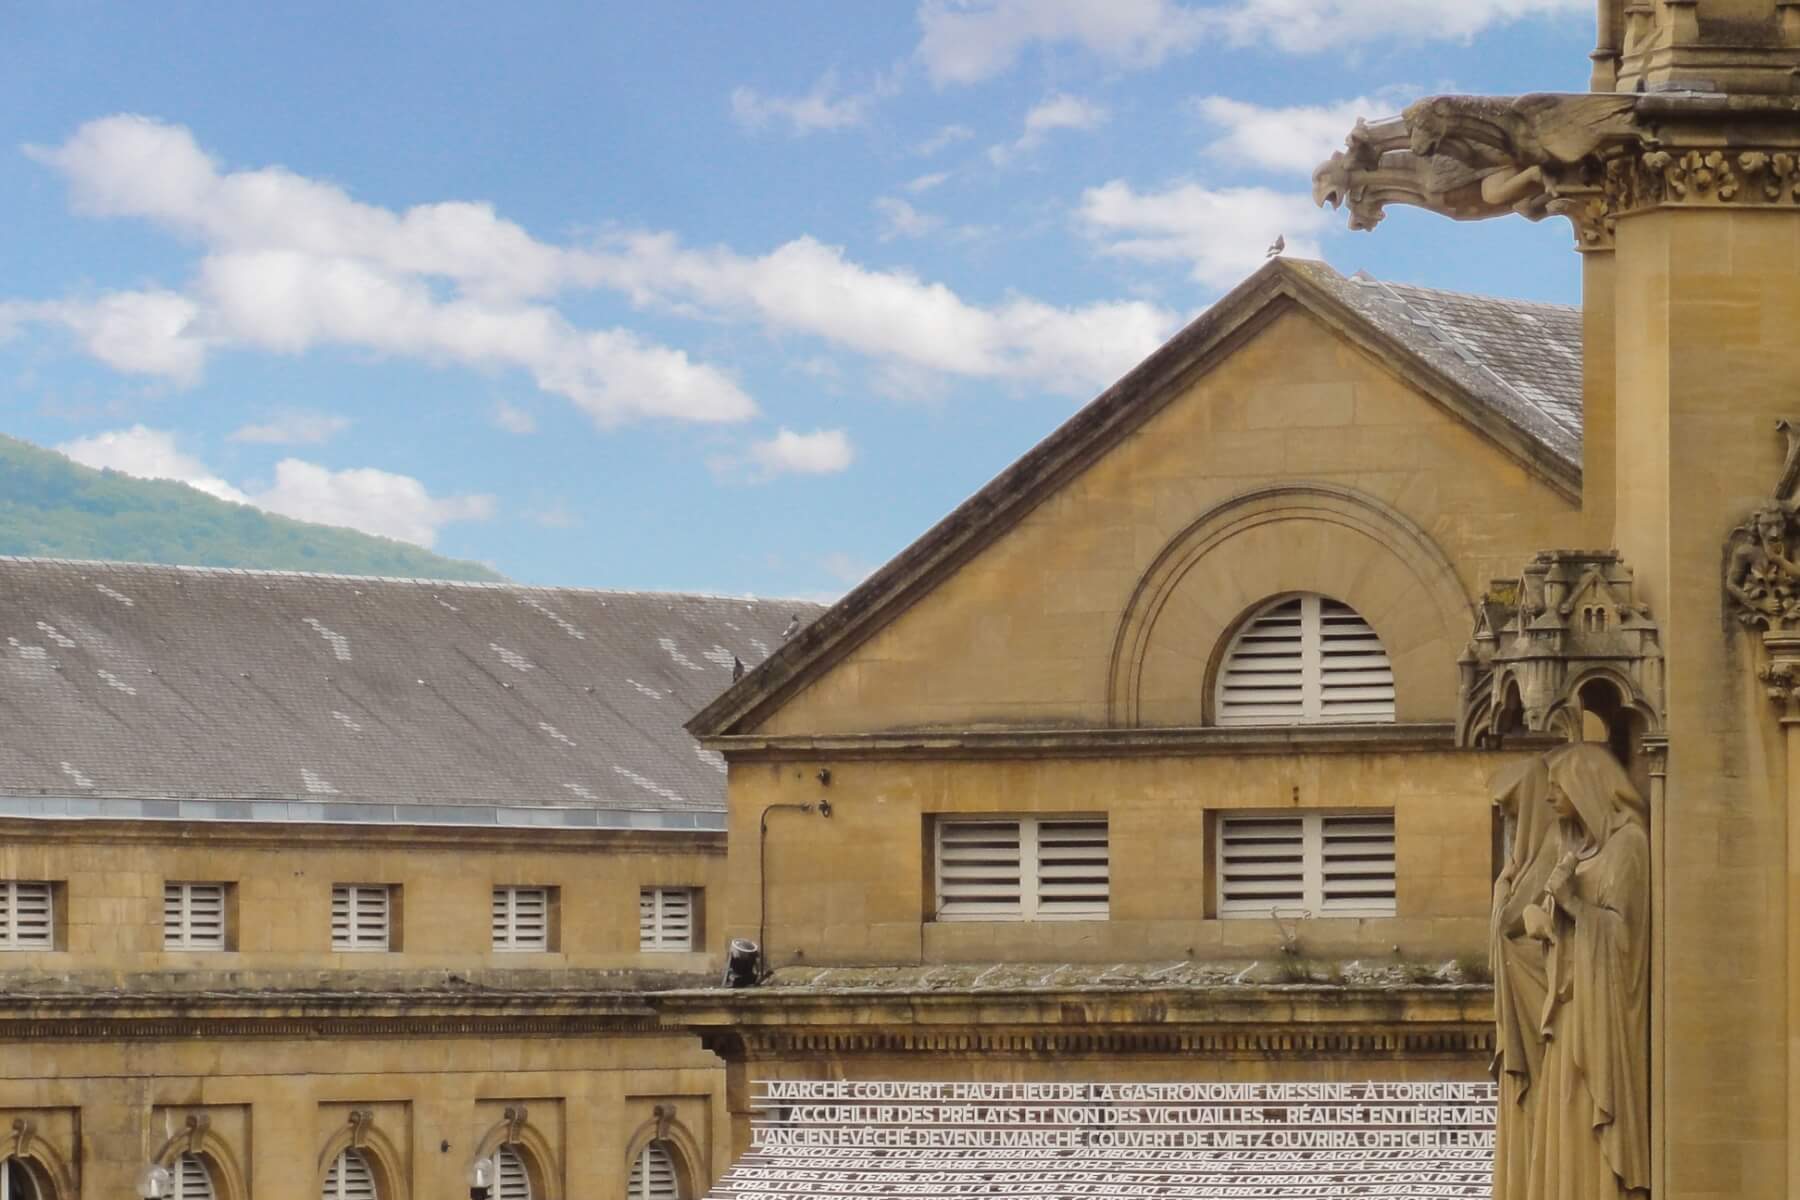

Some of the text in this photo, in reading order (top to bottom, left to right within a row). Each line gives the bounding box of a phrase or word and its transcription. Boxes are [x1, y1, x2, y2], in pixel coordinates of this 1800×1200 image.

[767, 1079, 849, 1099] MARCHÉ
[854, 1084, 947, 1104] COUVERT,
[953, 1084, 1009, 1100] HAUT
[1012, 1085, 1054, 1100] LIEU
[1058, 1085, 1084, 1100] DE
[1090, 1085, 1114, 1100] LA
[1119, 1085, 1262, 1100] GASTRONOMIE
[1363, 1080, 1382, 1100] À
[1383, 1085, 1480, 1104] L'ORIGINE,
[789, 1104, 1496, 1123] ACCUEILLIR DES PRÉLATS ET NON DES VICTUAILLES... RÉALISÉ ENTIÈREMEN
[753, 1131, 839, 1146] L'ANCIEN
[842, 1127, 914, 1146] ÉVÊCHÉ
[916, 1131, 997, 1146] DEVENU
[1002, 1127, 1083, 1147] MARCHÉ
[1088, 1132, 1177, 1147] COUVERT
[1183, 1132, 1209, 1147] DE
[1213, 1132, 1267, 1147] METZ
[1271, 1132, 1359, 1147] OUVRIRA
[884, 1148, 963, 1158] TOURTE
[1071, 1150, 1152, 1159] JAMBON
[1220, 1151, 1248, 1160] AU
[733, 1169, 822, 1179] POMMES
[823, 1172, 850, 1180] DE
[855, 1172, 914, 1181] TERRE
[992, 1173, 1071, 1182] BOULET
[1072, 1174, 1100, 1182] DE
[1343, 1174, 1430, 1184] COCHON
[1433, 1174, 1463, 1183] DE
